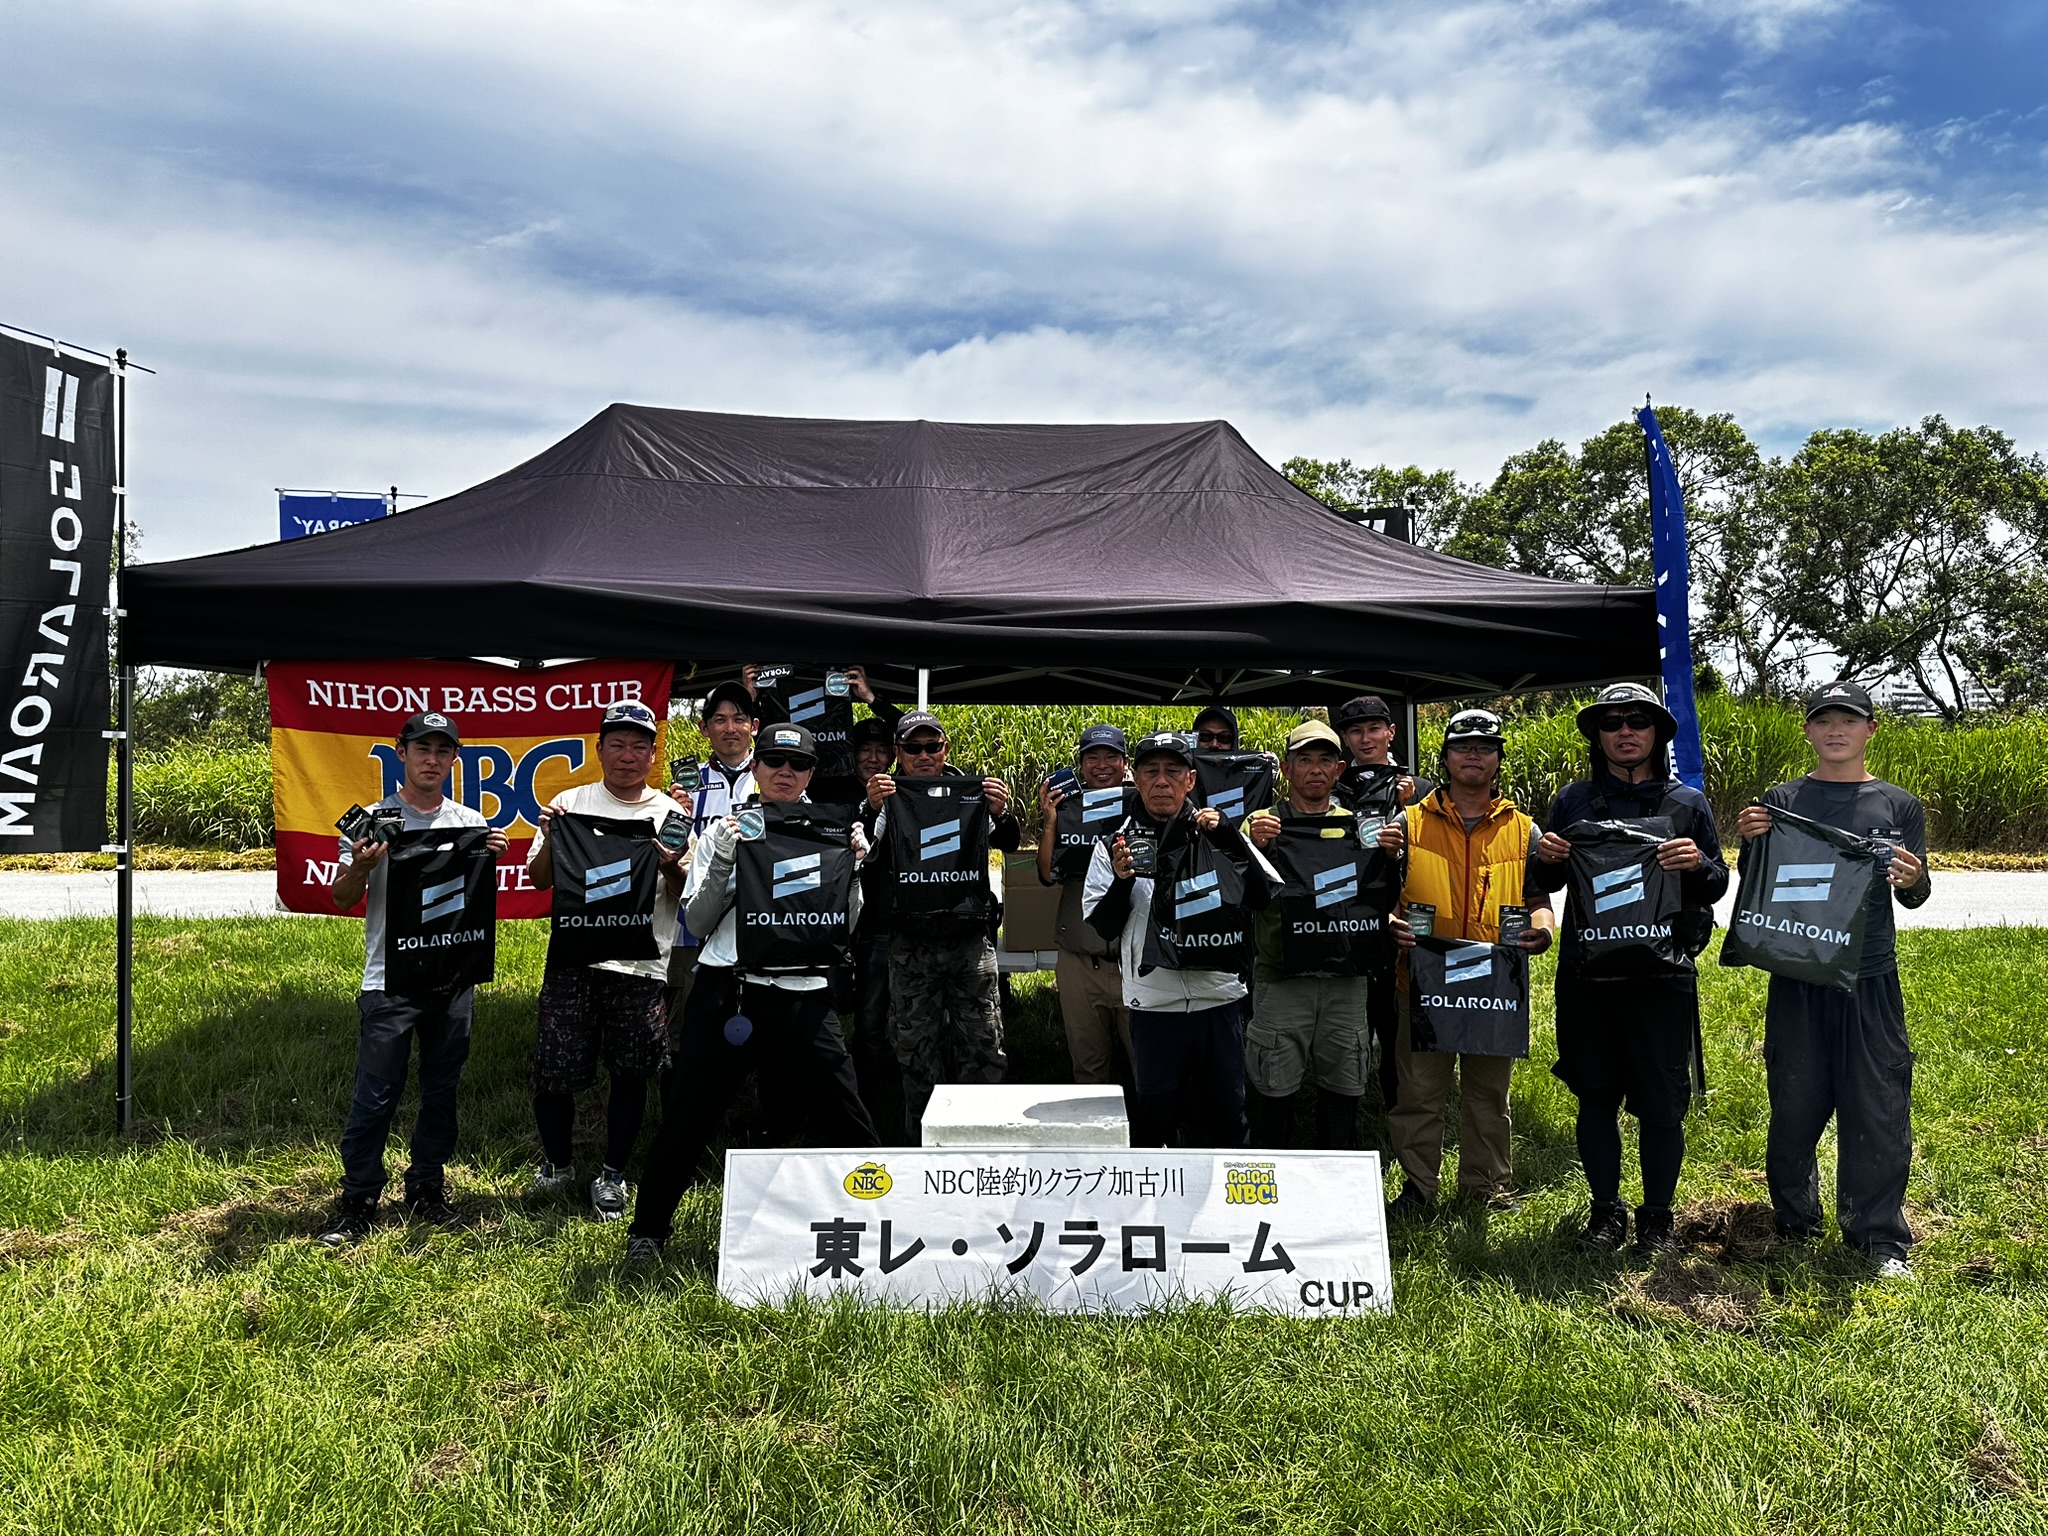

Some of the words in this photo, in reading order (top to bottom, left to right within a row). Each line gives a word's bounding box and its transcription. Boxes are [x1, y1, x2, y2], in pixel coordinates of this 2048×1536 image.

[306, 680, 431, 712] NIHON
[441, 686, 537, 712] BASS
[545, 680, 642, 711] CLUB
[904, 715, 933, 724] TORAY
[1061, 834, 1107, 845] SOLA
[900, 870, 979, 883] SOLAROAM
[559, 913, 654, 927] SOLAROAM
[746, 912, 845, 925] SOLAROAM
[1293, 918, 1379, 934] SOLAROAM
[1159, 926, 1243, 947] SOLAROAM
[1578, 924, 1672, 942] SOLAROAM
[1739, 910, 1851, 946] SOLAROAM
[398, 929, 485, 950] SOLAROAM
[1420, 995, 1517, 1011] SOLAROAM
[852, 1176, 884, 1190] NBC
[923, 1166, 1185, 1197] NBC陸釣りクラブ加古川
[1225, 1183, 1278, 1204] NBC!
[809, 1216, 1296, 1280] 東レ・ソラローム
[1300, 1280, 1374, 1308] CUP
